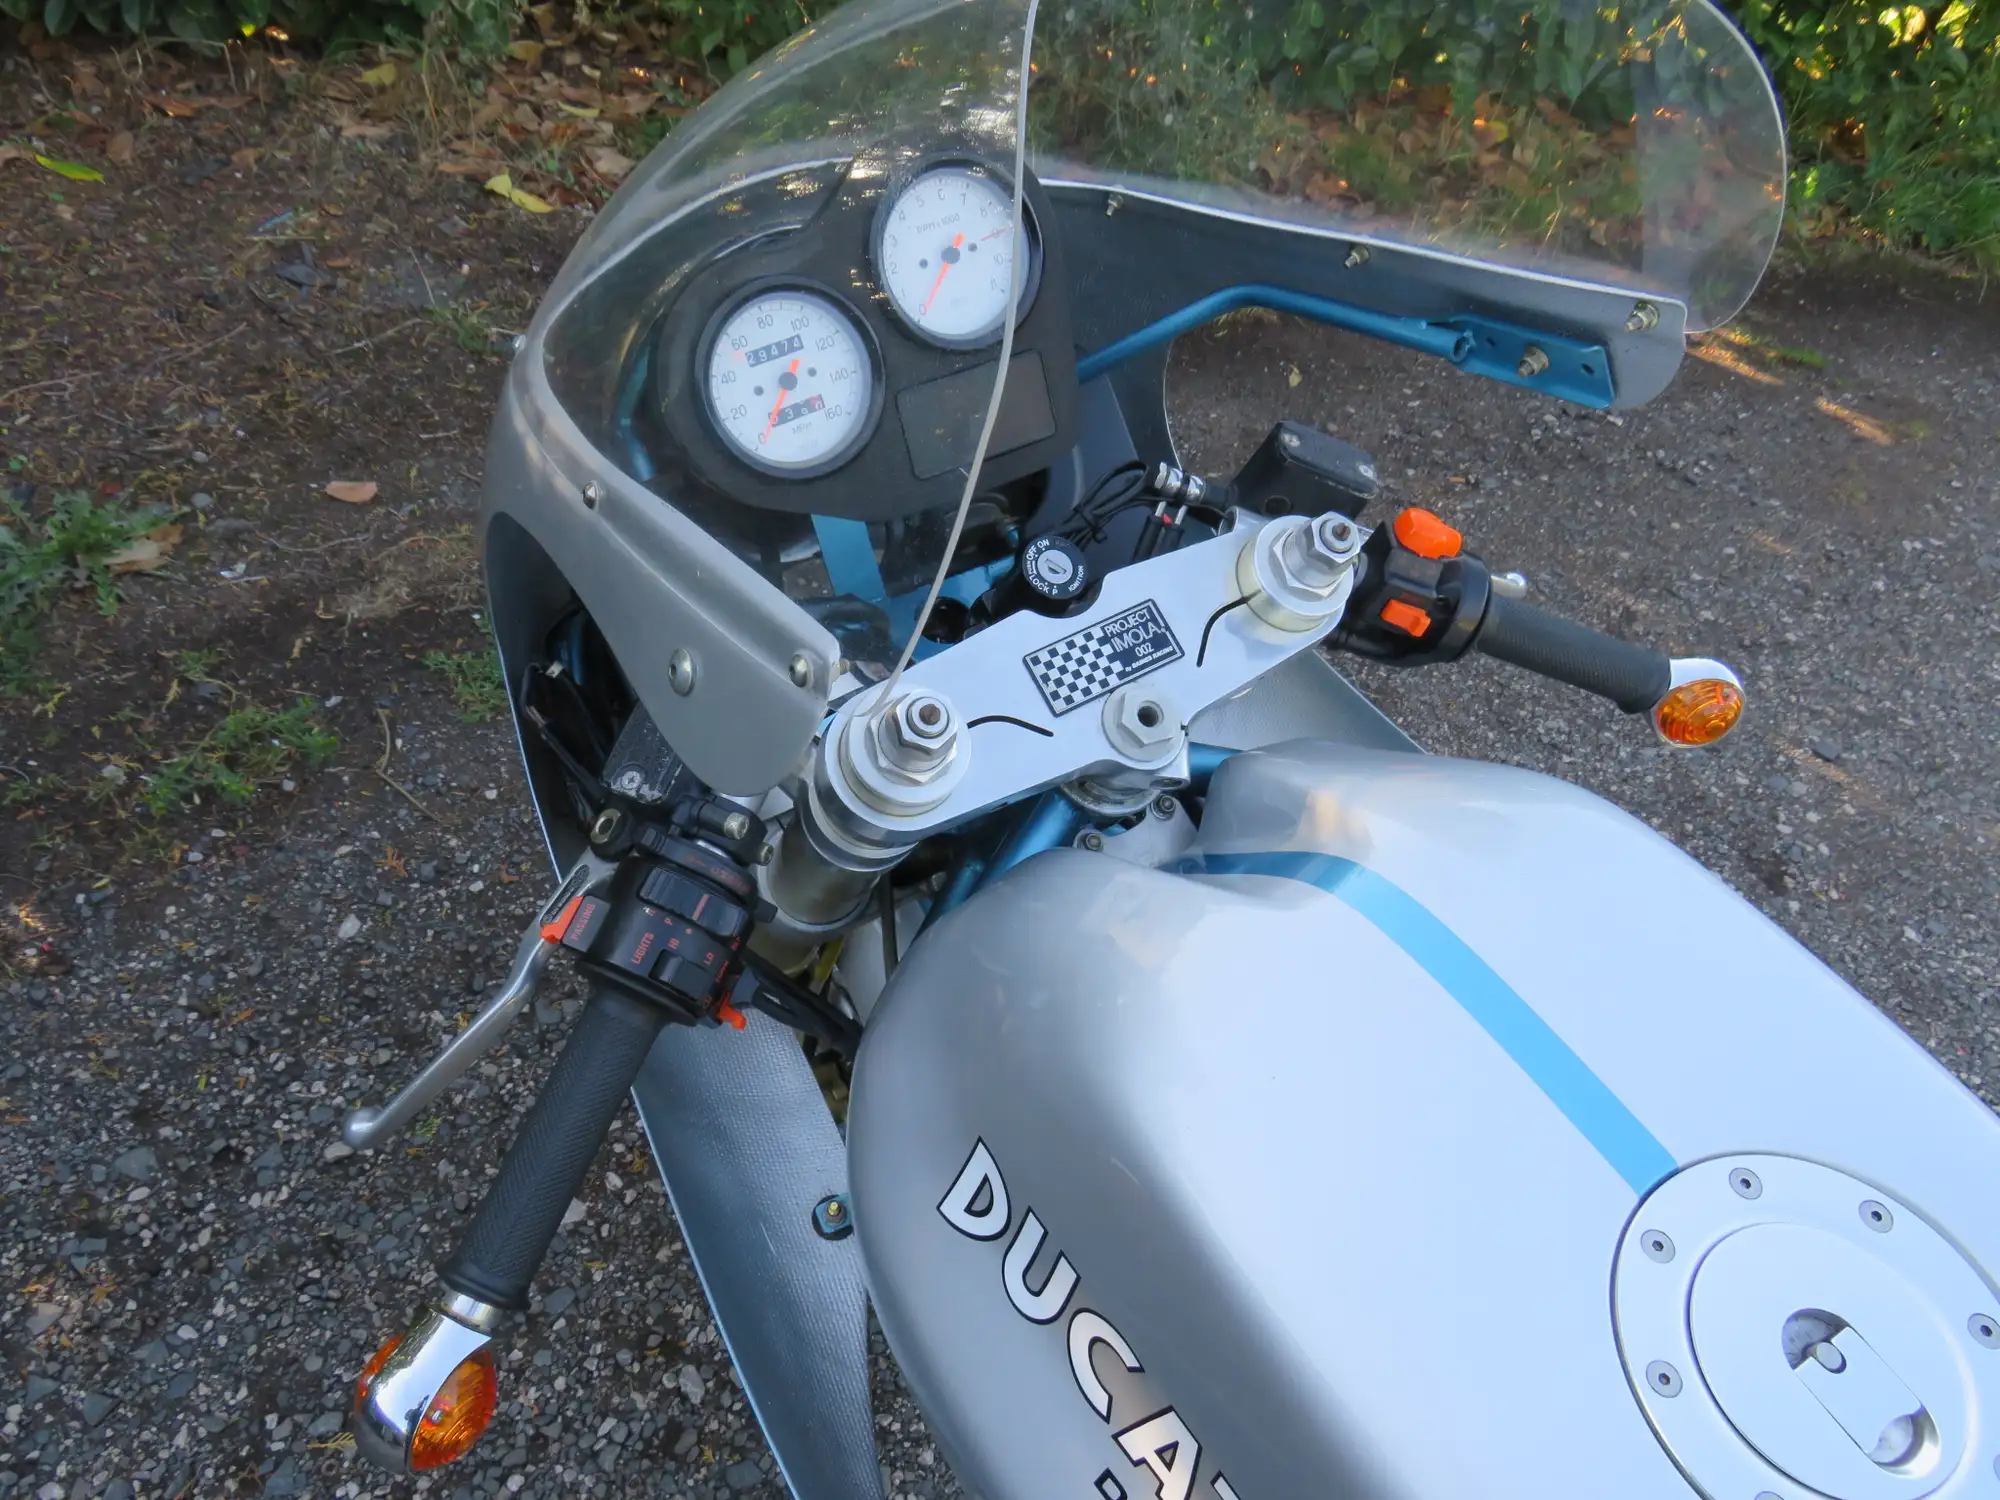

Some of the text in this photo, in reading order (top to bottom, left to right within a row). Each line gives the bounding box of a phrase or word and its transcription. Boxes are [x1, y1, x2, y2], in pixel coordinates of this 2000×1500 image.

[915, 196, 925, 208] 5
[937, 188, 946, 201] 6
[960, 193, 968, 207] 7
[898, 209, 906, 222] 4
[979, 206, 988, 218] 8
[889, 234, 898, 247] 3
[993, 254, 1004, 266] 10
[890, 262, 899, 275] 2
[756, 314, 775, 330] 80
[790, 316, 810, 333] 100
[731, 335, 748, 351] 60
[815, 335, 836, 352] 120
[746, 337, 801, 367] 29474
[720, 370, 737, 385] 40
[829, 366, 850, 384] 140
[730, 404, 747, 421] 20
[823, 404, 843, 421] 160
[1037, 538, 1050, 549] ON
[1026, 545, 1037, 561] OFF
[1029, 574, 1050, 594] LOCK
[1052, 588, 1058, 596] P
[1104, 609, 1151, 637] PROJECT
[1111, 621, 1162, 653] IMOLA
[1134, 642, 1155, 657] 002
[570, 903, 596, 941] PASSING
[631, 932, 655, 965] LIGHTS
[668, 938, 681, 950] HI
[936, 1135, 1241, 1500] DUCA
